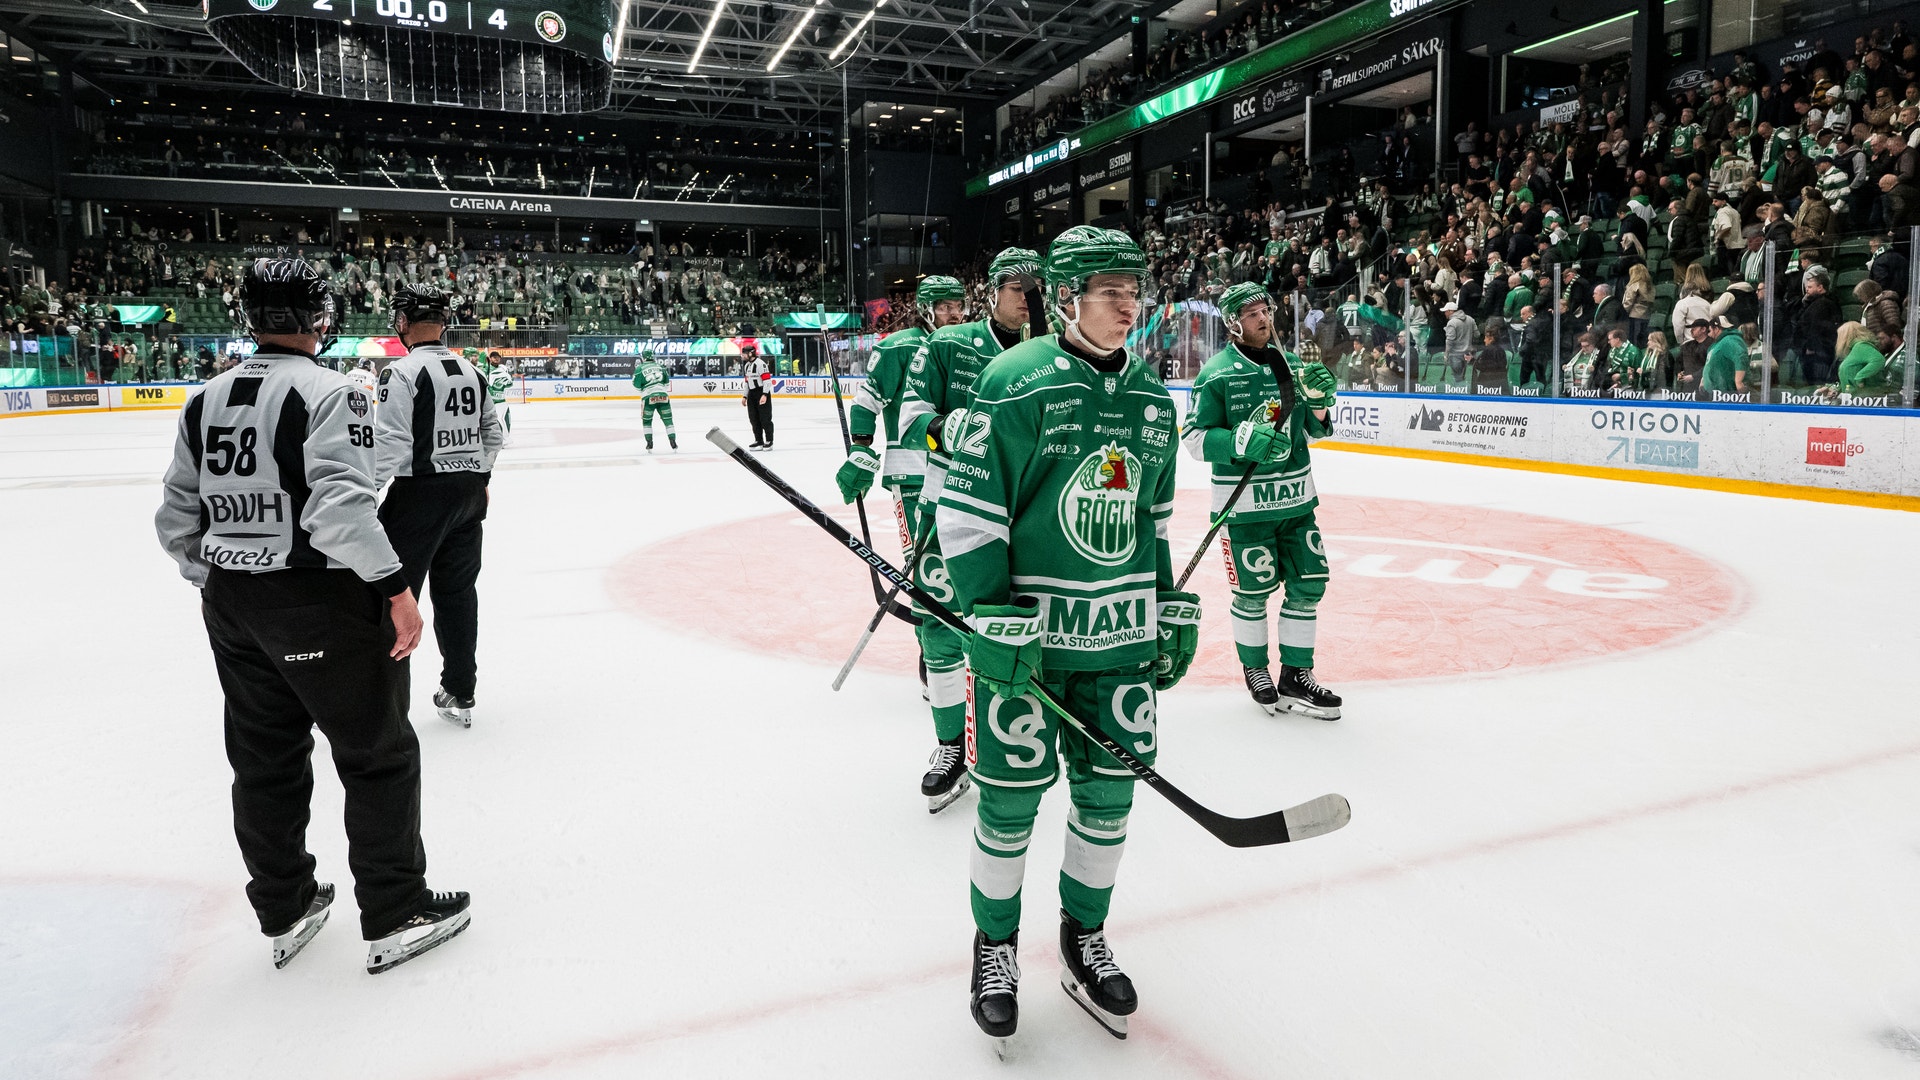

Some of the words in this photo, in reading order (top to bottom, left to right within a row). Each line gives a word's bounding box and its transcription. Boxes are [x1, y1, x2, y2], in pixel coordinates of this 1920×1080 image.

[397, 18, 421, 27] PERIOD
[488, 8, 508, 30] 4
[1402, 38, 1444, 65] SÄKR
[1332, 58, 1393, 90] RETAILSUPPORT
[1234, 96, 1256, 120] RCC
[1115, 152, 1132, 167] STENA
[1034, 188, 1047, 202] SEB
[450, 198, 506, 211] CATENA
[510, 200, 552, 213] Arena
[277, 246, 289, 254] RV
[1343, 311, 1358, 326] 71
[614, 339, 635, 354] FÖR
[910, 346, 929, 374] 5
[1006, 364, 1056, 397] Backahill
[1352, 382, 1371, 392] Boozt
[1378, 383, 1399, 392] Boozt
[136, 388, 164, 399] MVB
[379, 388, 389, 403] 9
[566, 385, 609, 393] Tranpenad
[786, 386, 807, 394] SPORT
[1415, 383, 1437, 394] Boozt
[1445, 384, 1468, 394] Boozt
[1477, 385, 1502, 395] Boozt
[1513, 386, 1540, 397] Boozt
[1570, 387, 1601, 398] Boozt
[1614, 388, 1646, 400] Boozt
[1661, 388, 1697, 402] Boozt
[4, 391, 33, 411] VISA
[61, 393, 98, 402] XL-BYGG
[445, 387, 476, 417] 49
[1712, 389, 1751, 404] Boozt
[1781, 392, 1826, 405] Boozt
[1840, 393, 1888, 408] Boozt
[1046, 398, 1083, 413] Bevaclear
[1448, 413, 1528, 427] BETONGBORRNING
[1592, 410, 1701, 435] ORIGON
[348, 424, 375, 449] 58
[1045, 423, 1083, 436] MARCON
[1448, 424, 1453, 432] &
[1458, 423, 1506, 437] SÅGNING
[1510, 428, 1526, 438] AB
[438, 427, 480, 449] BWH
[1432, 439, 1496, 451] www.betongborrning.nu
[206, 426, 257, 477] 58
[1042, 442, 1067, 456] akea
[1640, 443, 1692, 463] PARK
[1810, 440, 1865, 457] menigo
[436, 457, 481, 471] Hotels
[1253, 481, 1305, 503] MAXI
[207, 493, 284, 523] BWH
[204, 545, 278, 567] Hotels
[856, 546, 915, 592] BAUER
[1050, 596, 1146, 637] MAXI
[1161, 605, 1203, 620] BAU
[985, 621, 1044, 637] BAU
[1046, 635, 1066, 646] ICA
[1069, 630, 1146, 649] STORMARKNAD
[284, 651, 324, 662] CCM
[1103, 740, 1159, 784] FLYLITE
